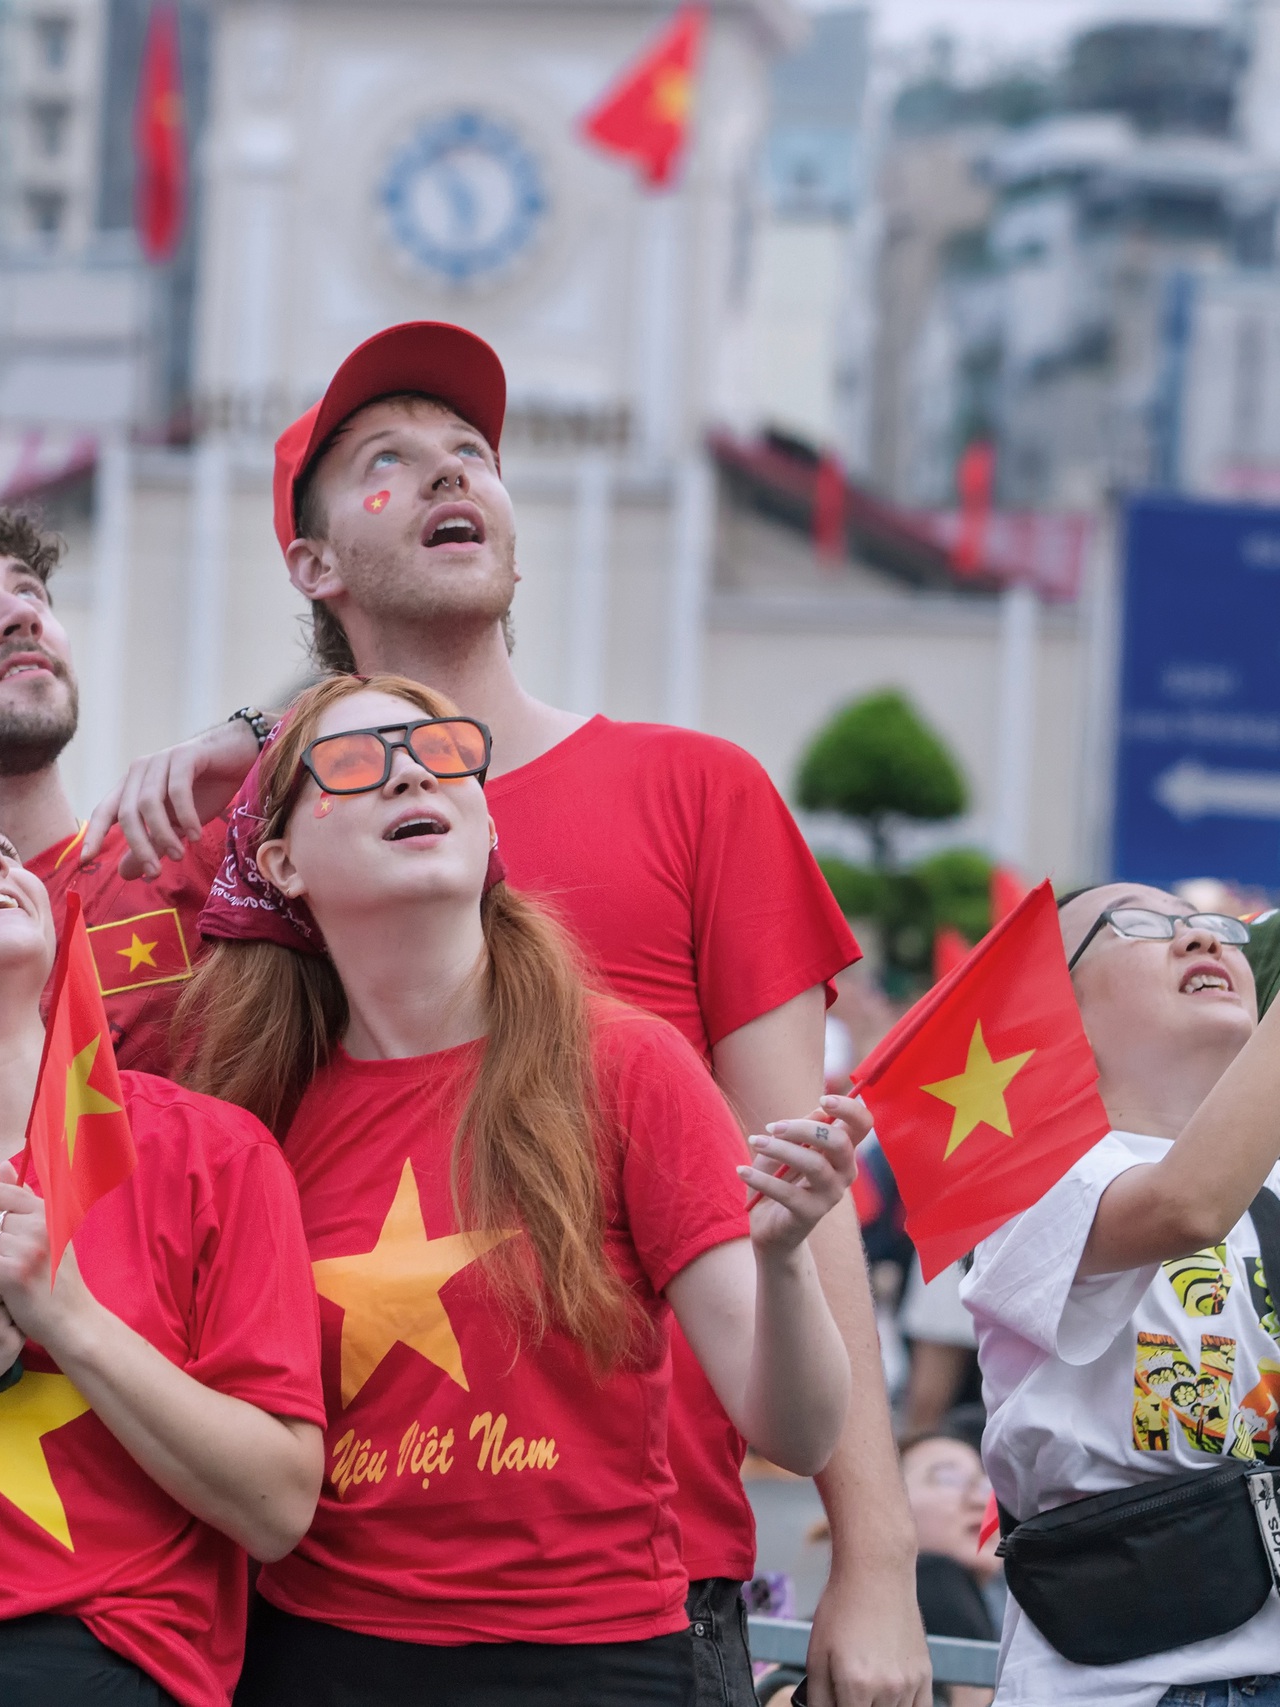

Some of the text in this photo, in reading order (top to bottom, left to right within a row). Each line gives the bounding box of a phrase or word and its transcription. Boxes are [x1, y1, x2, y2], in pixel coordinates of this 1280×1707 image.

[330, 1411, 559, 1499] Yêu Việt Nam
